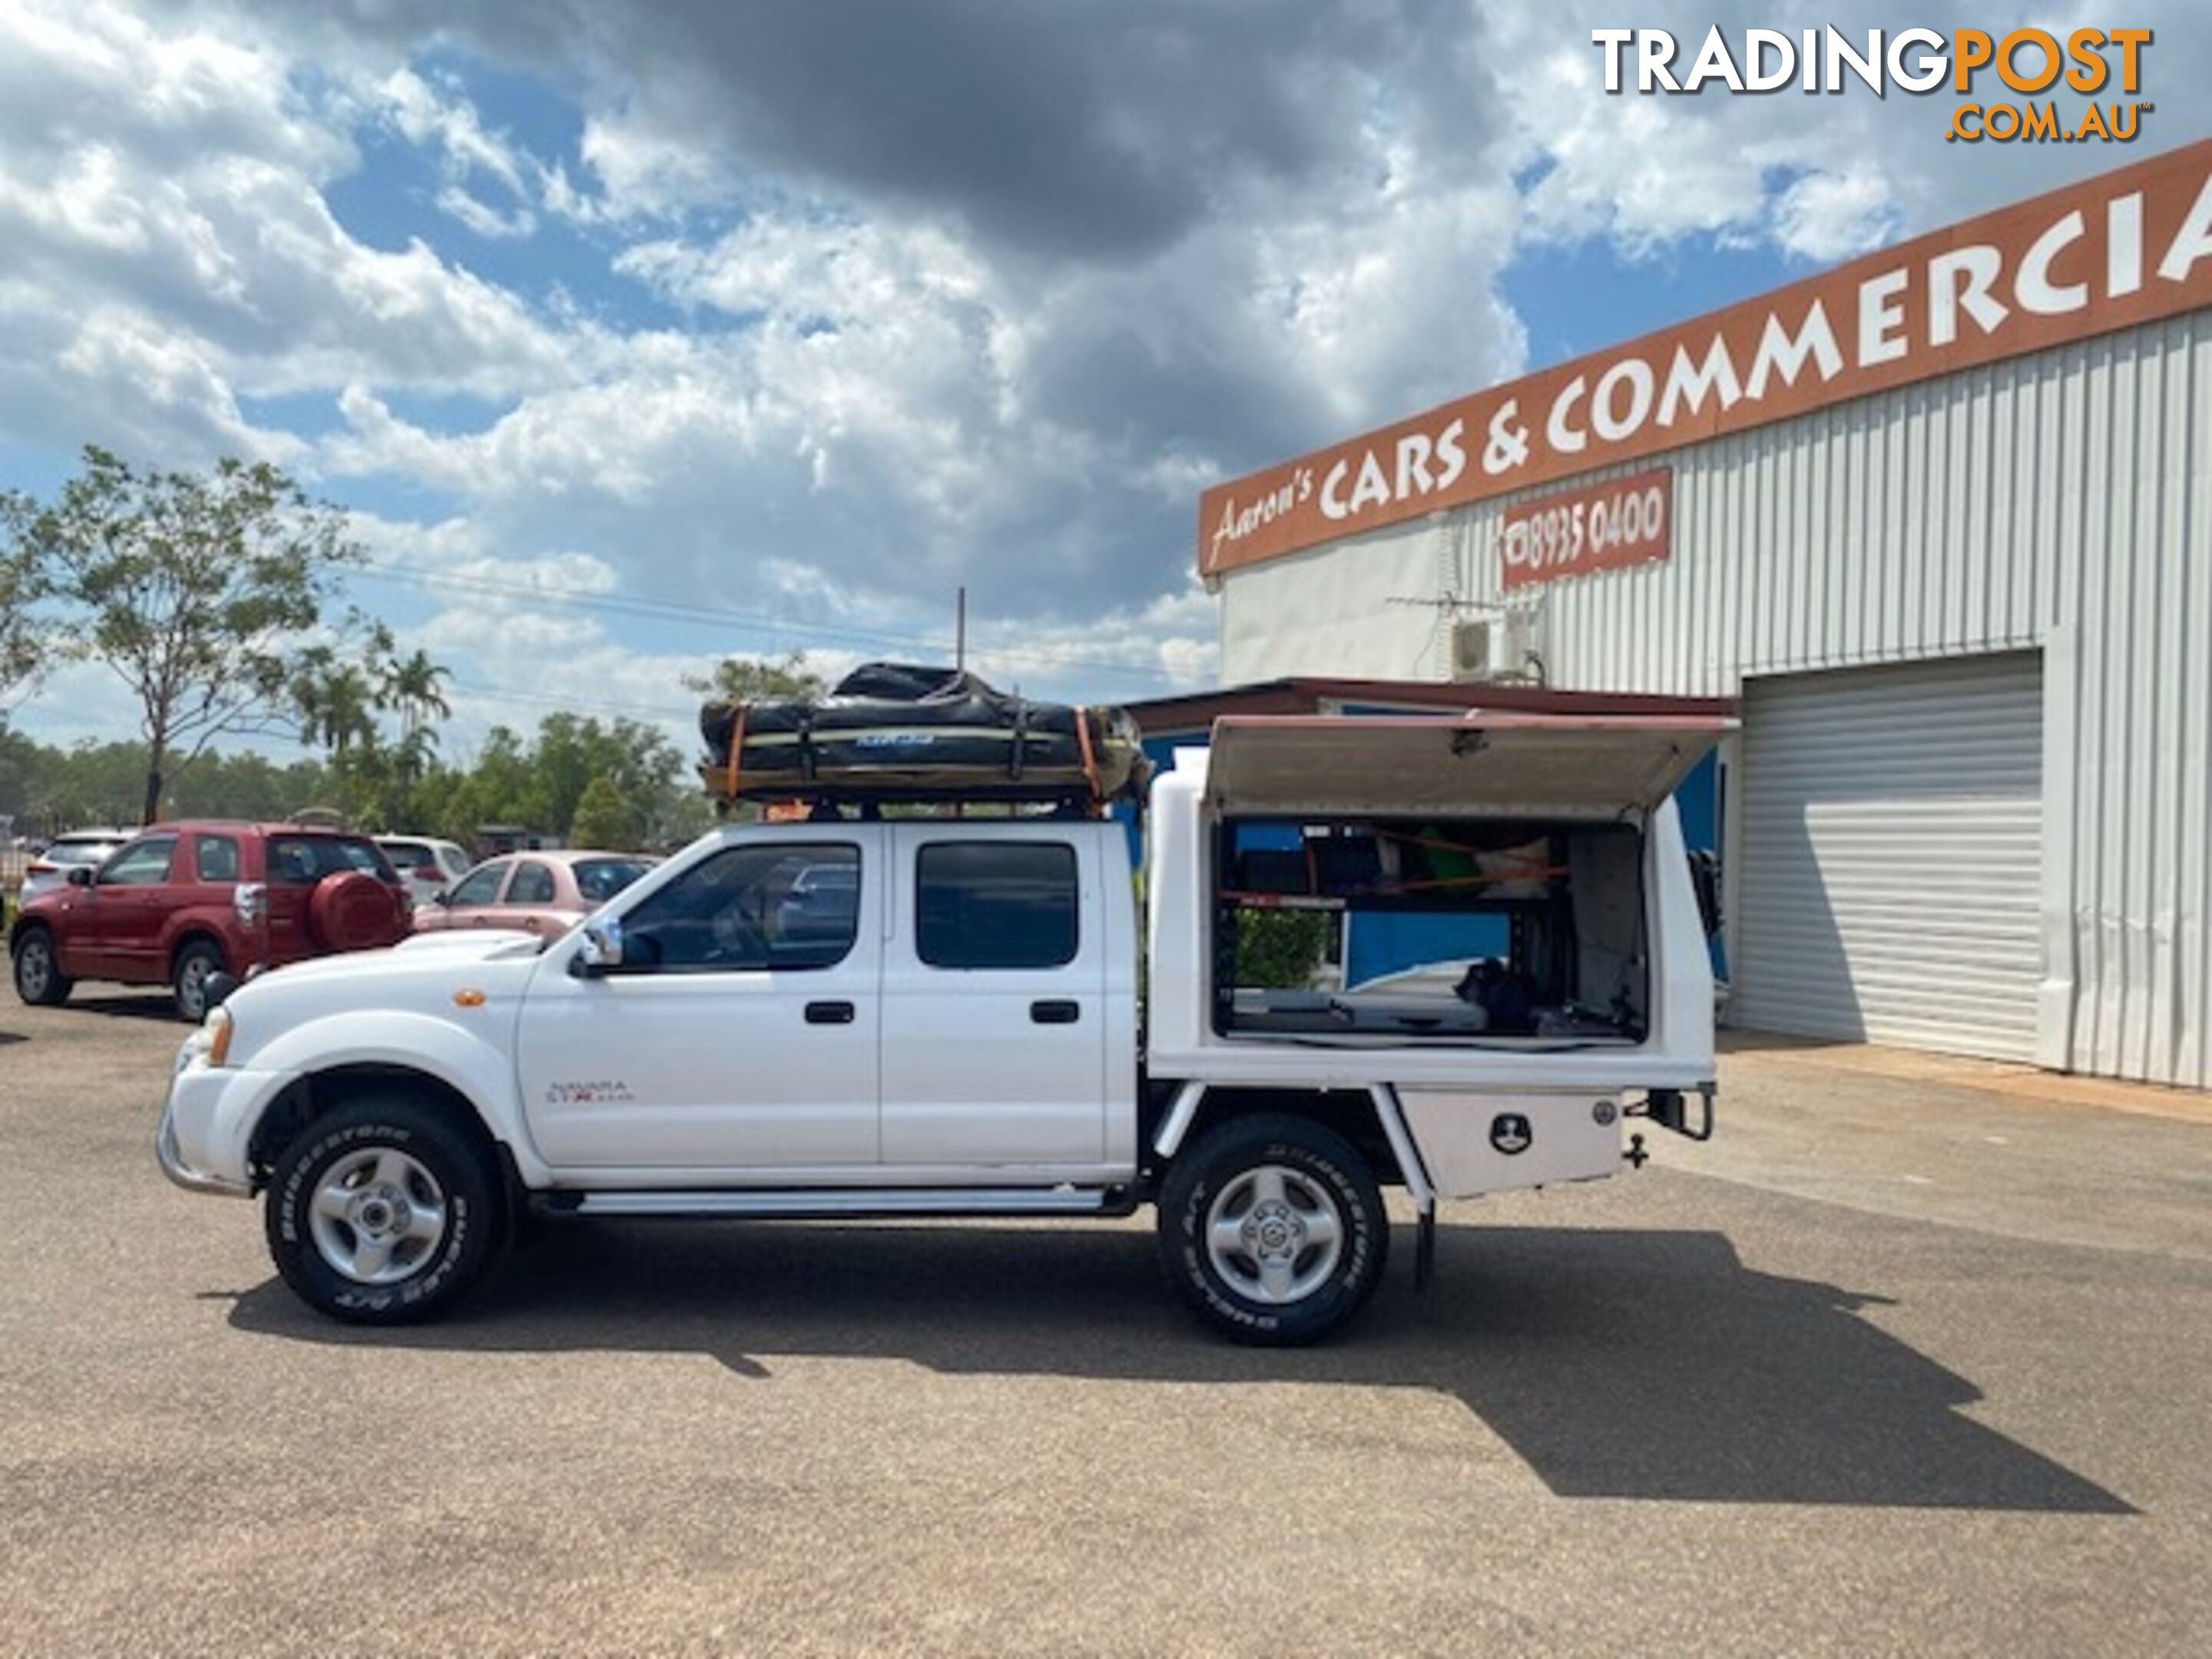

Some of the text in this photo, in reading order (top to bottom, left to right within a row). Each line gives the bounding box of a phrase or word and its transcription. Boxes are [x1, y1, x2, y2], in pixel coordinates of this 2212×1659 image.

[1208, 469, 1313, 568] Aaron's
[1320, 419, 1463, 519] CARS
[1482, 399, 1528, 475] &
[1528, 486, 1664, 570] 8935 0400
